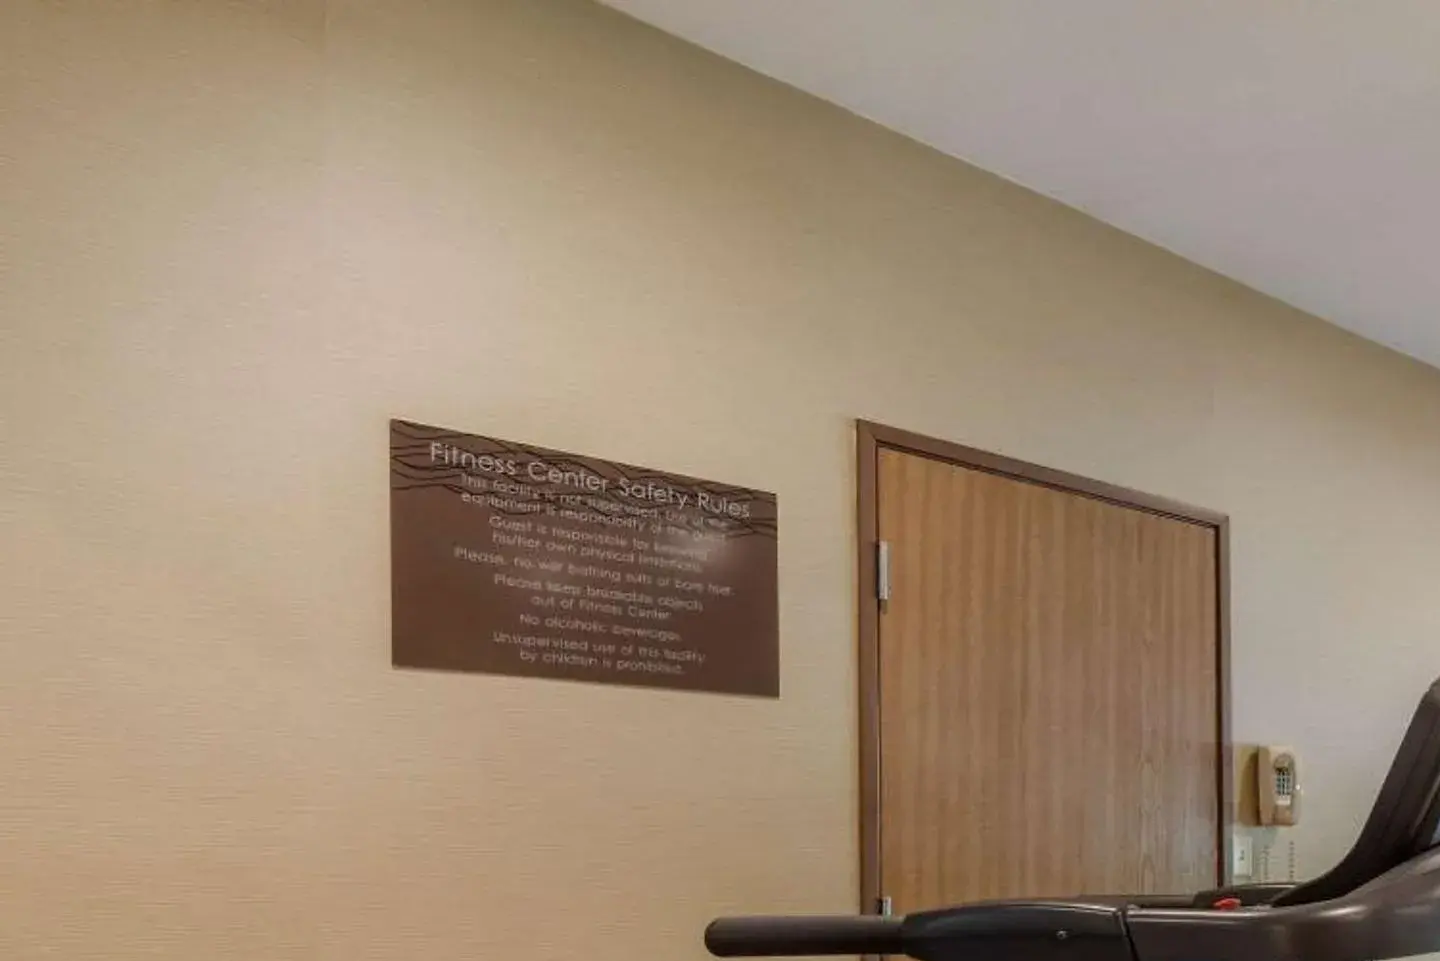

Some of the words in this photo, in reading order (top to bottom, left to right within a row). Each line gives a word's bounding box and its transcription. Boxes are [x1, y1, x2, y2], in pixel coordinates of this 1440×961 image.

[431, 441, 516, 475] Fitness
[527, 461, 609, 492] Center
[618, 477, 688, 509] Safety
[697, 492, 750, 518] Rules
